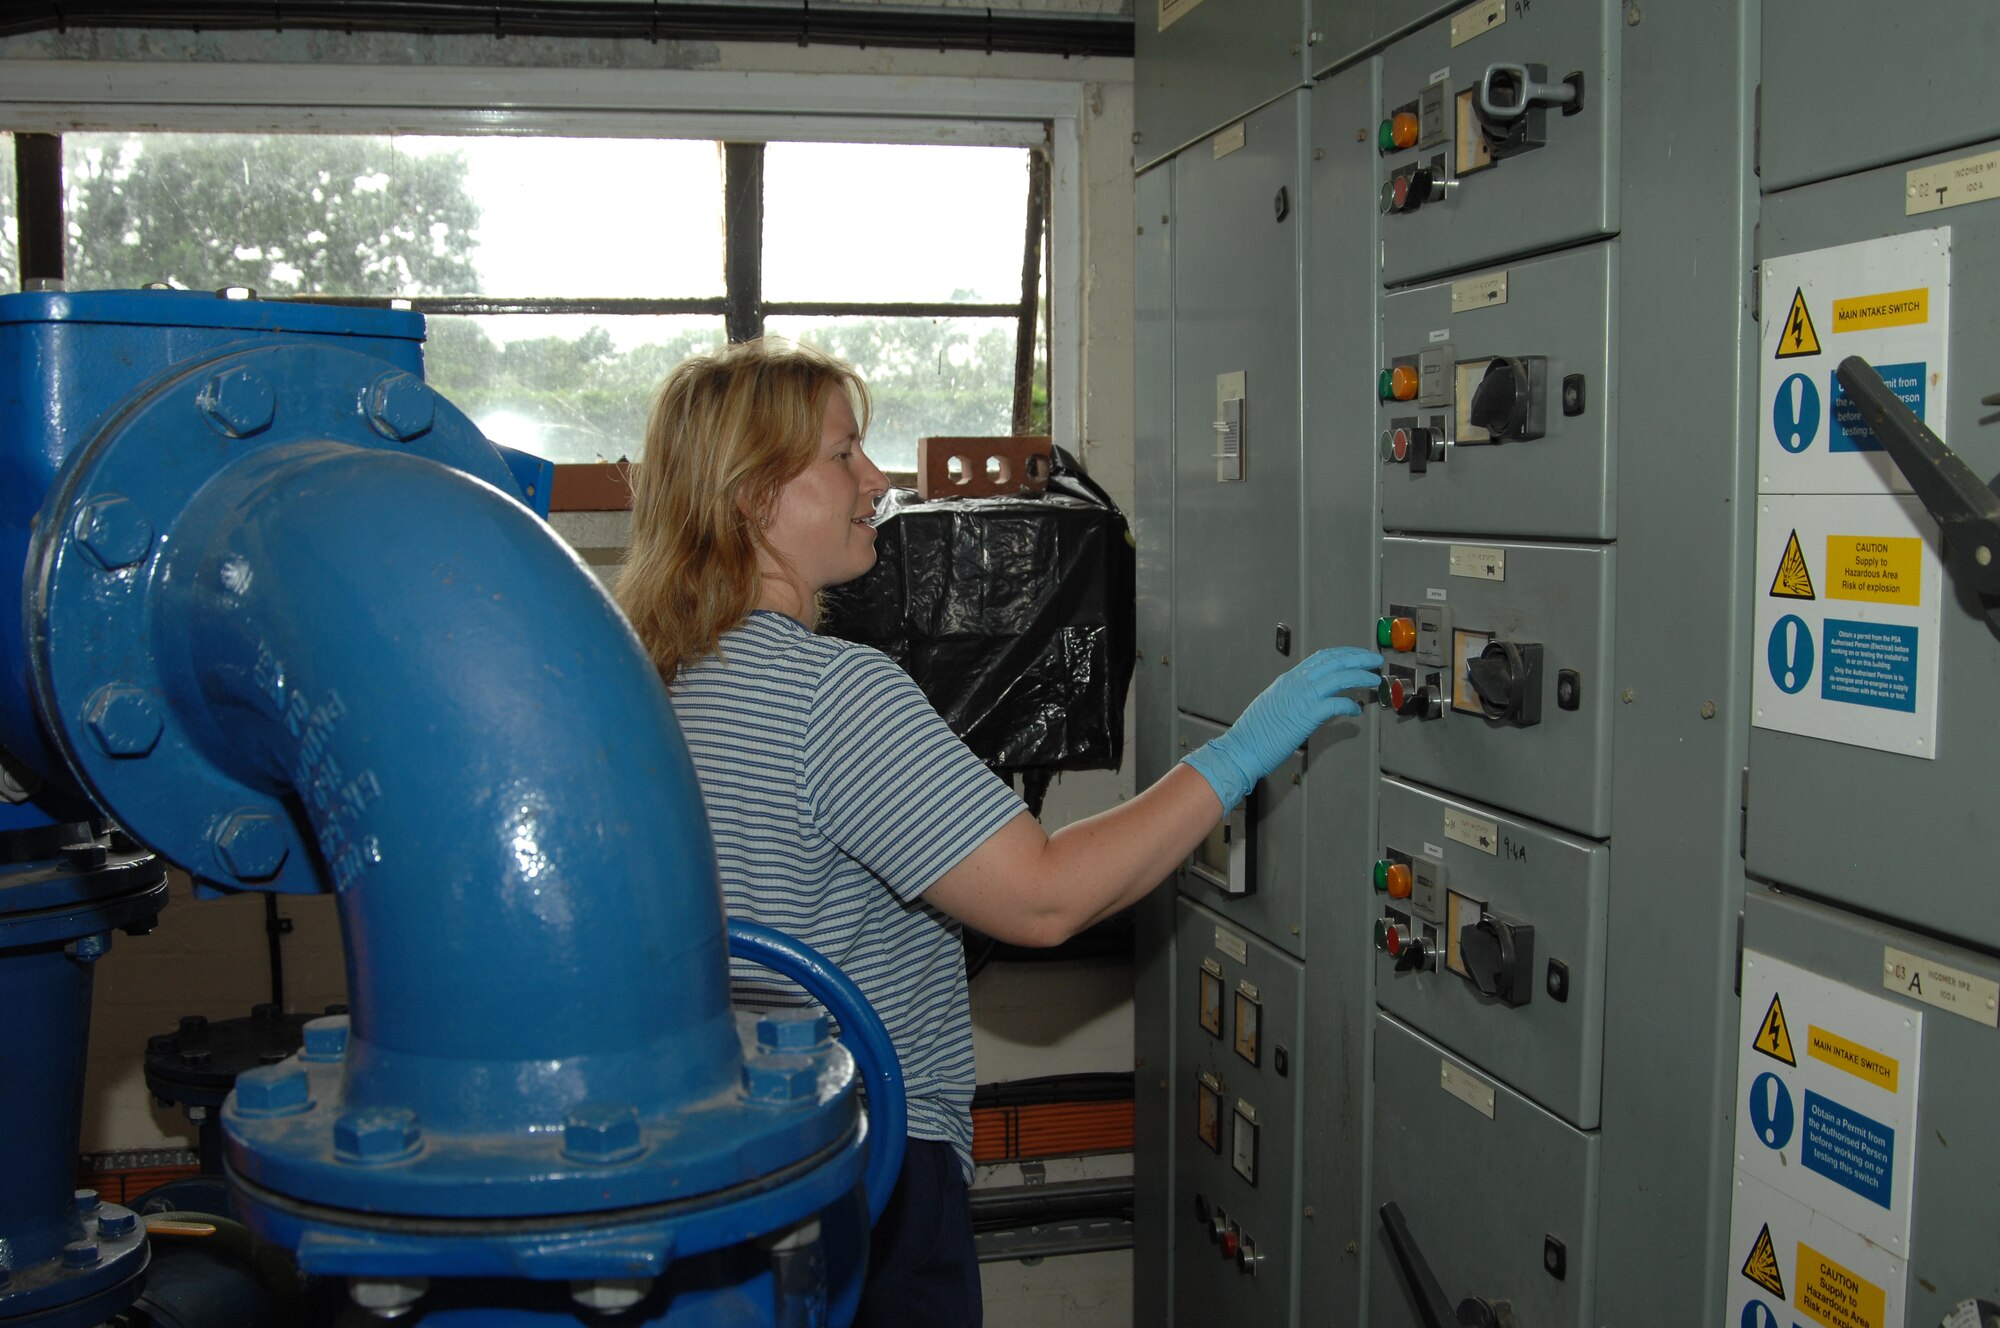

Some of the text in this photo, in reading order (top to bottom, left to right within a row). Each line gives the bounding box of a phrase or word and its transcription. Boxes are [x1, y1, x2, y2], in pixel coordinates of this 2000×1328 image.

[1936, 186, 1948, 205] T
[1838, 301, 1920, 320] MAIN INTAKE SWITCH
[1898, 377, 1917, 387] from
[1836, 398, 1847, 406] the
[1837, 412, 1862, 421] before
[1842, 427, 1867, 437] testing
[1855, 543, 1888, 553] CAUTION
[1855, 556, 1888, 568] Supply to
[1844, 568, 1898, 580] Hazardous Area
[1842, 580, 1901, 594] Risk of explosion
[1831, 648, 1848, 656] working
[1861, 651, 1875, 660] testing
[1894, 645, 1909, 653] before
[1834, 666, 1844, 675] Only
[1876, 672, 1893, 680] Person
[1836, 685, 1859, 693] connection
[1893, 684, 1909, 693] supply
[1908, 972, 1922, 995] A
[1928, 970, 1956, 986] INCOMER
[1813, 1038, 1890, 1078] MAIN INTAKE SWITCH
[1811, 1104, 1835, 1122] Obtain
[1842, 1119, 1866, 1137] Permit
[1868, 1131, 1886, 1148] from
[1808, 1117, 1888, 1164] the Authorised Person
[1810, 1131, 1884, 1176] before working on or
[1814, 1148, 1879, 1188] testing this switch
[1820, 1263, 1859, 1294] CAUTION
[1820, 1277, 1857, 1307] Supply to
[1804, 1295, 1821, 1314] Risk
[1822, 1309, 1831, 1320] of
[1806, 1283, 1870, 1328] Hazardous Area
